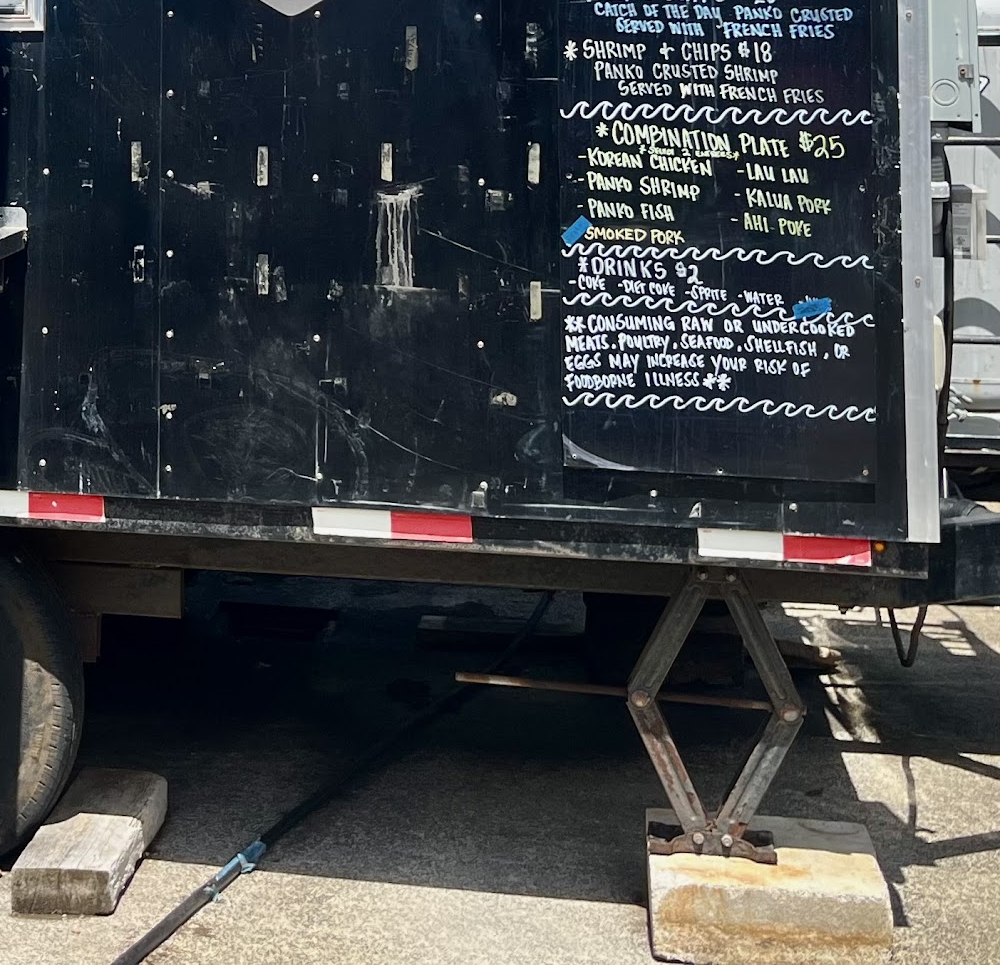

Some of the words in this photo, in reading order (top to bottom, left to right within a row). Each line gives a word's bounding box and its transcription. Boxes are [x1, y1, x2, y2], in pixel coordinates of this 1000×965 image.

[593, 2, 638, 18] CATCH
[643, 5, 660, 19] OF
[662, 5, 689, 20] THE
[734, 6, 783, 22] PANKO
[790, 7, 853, 23] CRUSTED
[615, 17, 664, 34] SERVED
[669, 20, 705, 37] WITH
[723, 22, 783, 39] FRENCH
[789, 23, 835, 39] FRIES
[583, 39, 647, 61] SHRIMP
[681, 42, 731, 61] CHIPS
[738, 41, 773, 63] $18
[594, 61, 643, 81] PANKO
[653, 62, 718, 81] CRUSTED
[723, 64, 779, 85] SHRIMP
[618, 81, 672, 97] SERVED
[679, 81, 716, 99] WITH
[719, 84, 778, 103] FRENCH
[783, 89, 824, 104] FRIES
[611, 119, 731, 154] COMBINATION
[738, 132, 790, 159] PLATE
[799, 130, 845, 159] $25
[681, 148, 691, 156] 2
[650, 153, 713, 177] CHICKEN
[780, 167, 809, 184] LAU
[639, 176, 701, 201] SHRIMP
[640, 202, 675, 221] FISH
[797, 195, 832, 214] PORK
[584, 226, 647, 243] SMOKED
[651, 229, 685, 245] PORK
[778, 218, 812, 237] POKE
[591, 257, 667, 280] DRINKS
[675, 261, 704, 285] $2
[649, 281, 676, 297] COKE
[587, 313, 676, 333] CONSUMING
[681, 316, 713, 332] RAW
[724, 319, 744, 333] OR
[752, 320, 855, 337] UNDERCOOKED
[834, 343, 850, 359] OR
[564, 352, 601, 371] EGGS
[608, 354, 640, 374] MAY
[646, 353, 704, 368] INCREASE
[711, 354, 747, 376] YOUR
[754, 358, 787, 375] RISK
[792, 362, 811, 377] OF
[564, 373, 636, 392] FOODBORNE
[645, 372, 700, 387] ILLNESS
